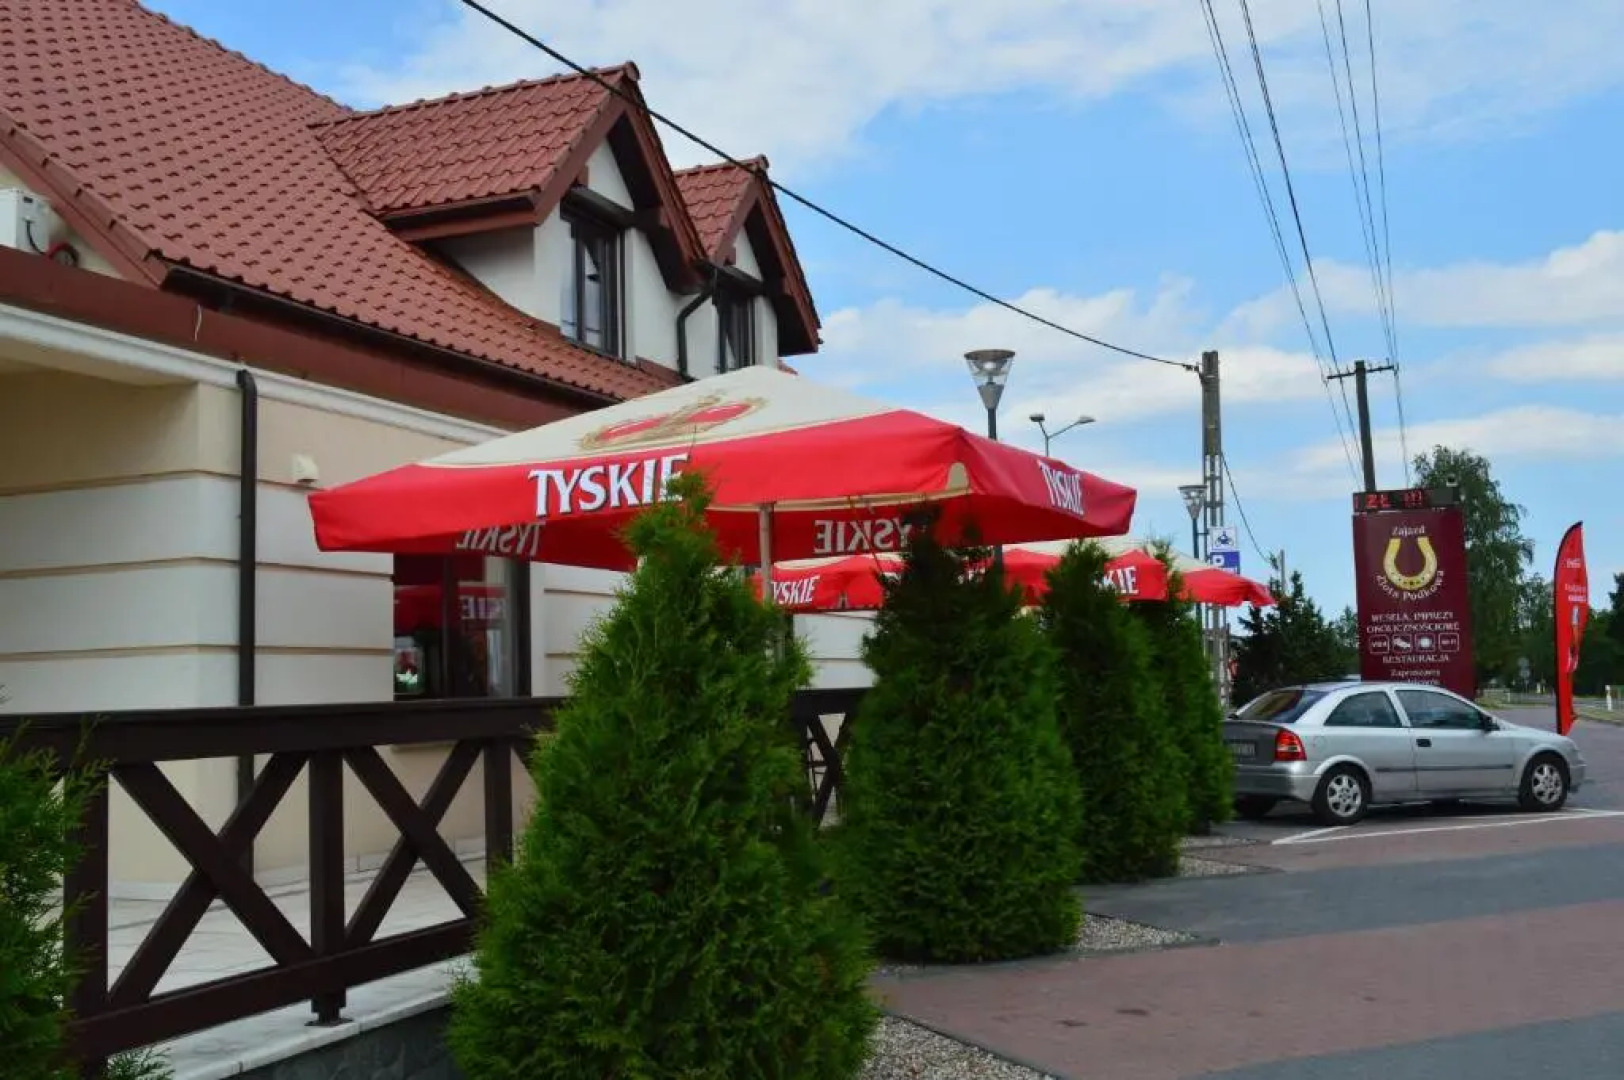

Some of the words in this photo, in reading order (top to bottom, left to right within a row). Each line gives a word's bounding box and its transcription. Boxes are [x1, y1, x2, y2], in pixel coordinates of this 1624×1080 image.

[528, 452, 689, 517] TYSKIE
[1036, 459, 1084, 515] TYSKIE
[771, 575, 820, 605] YSKIE
